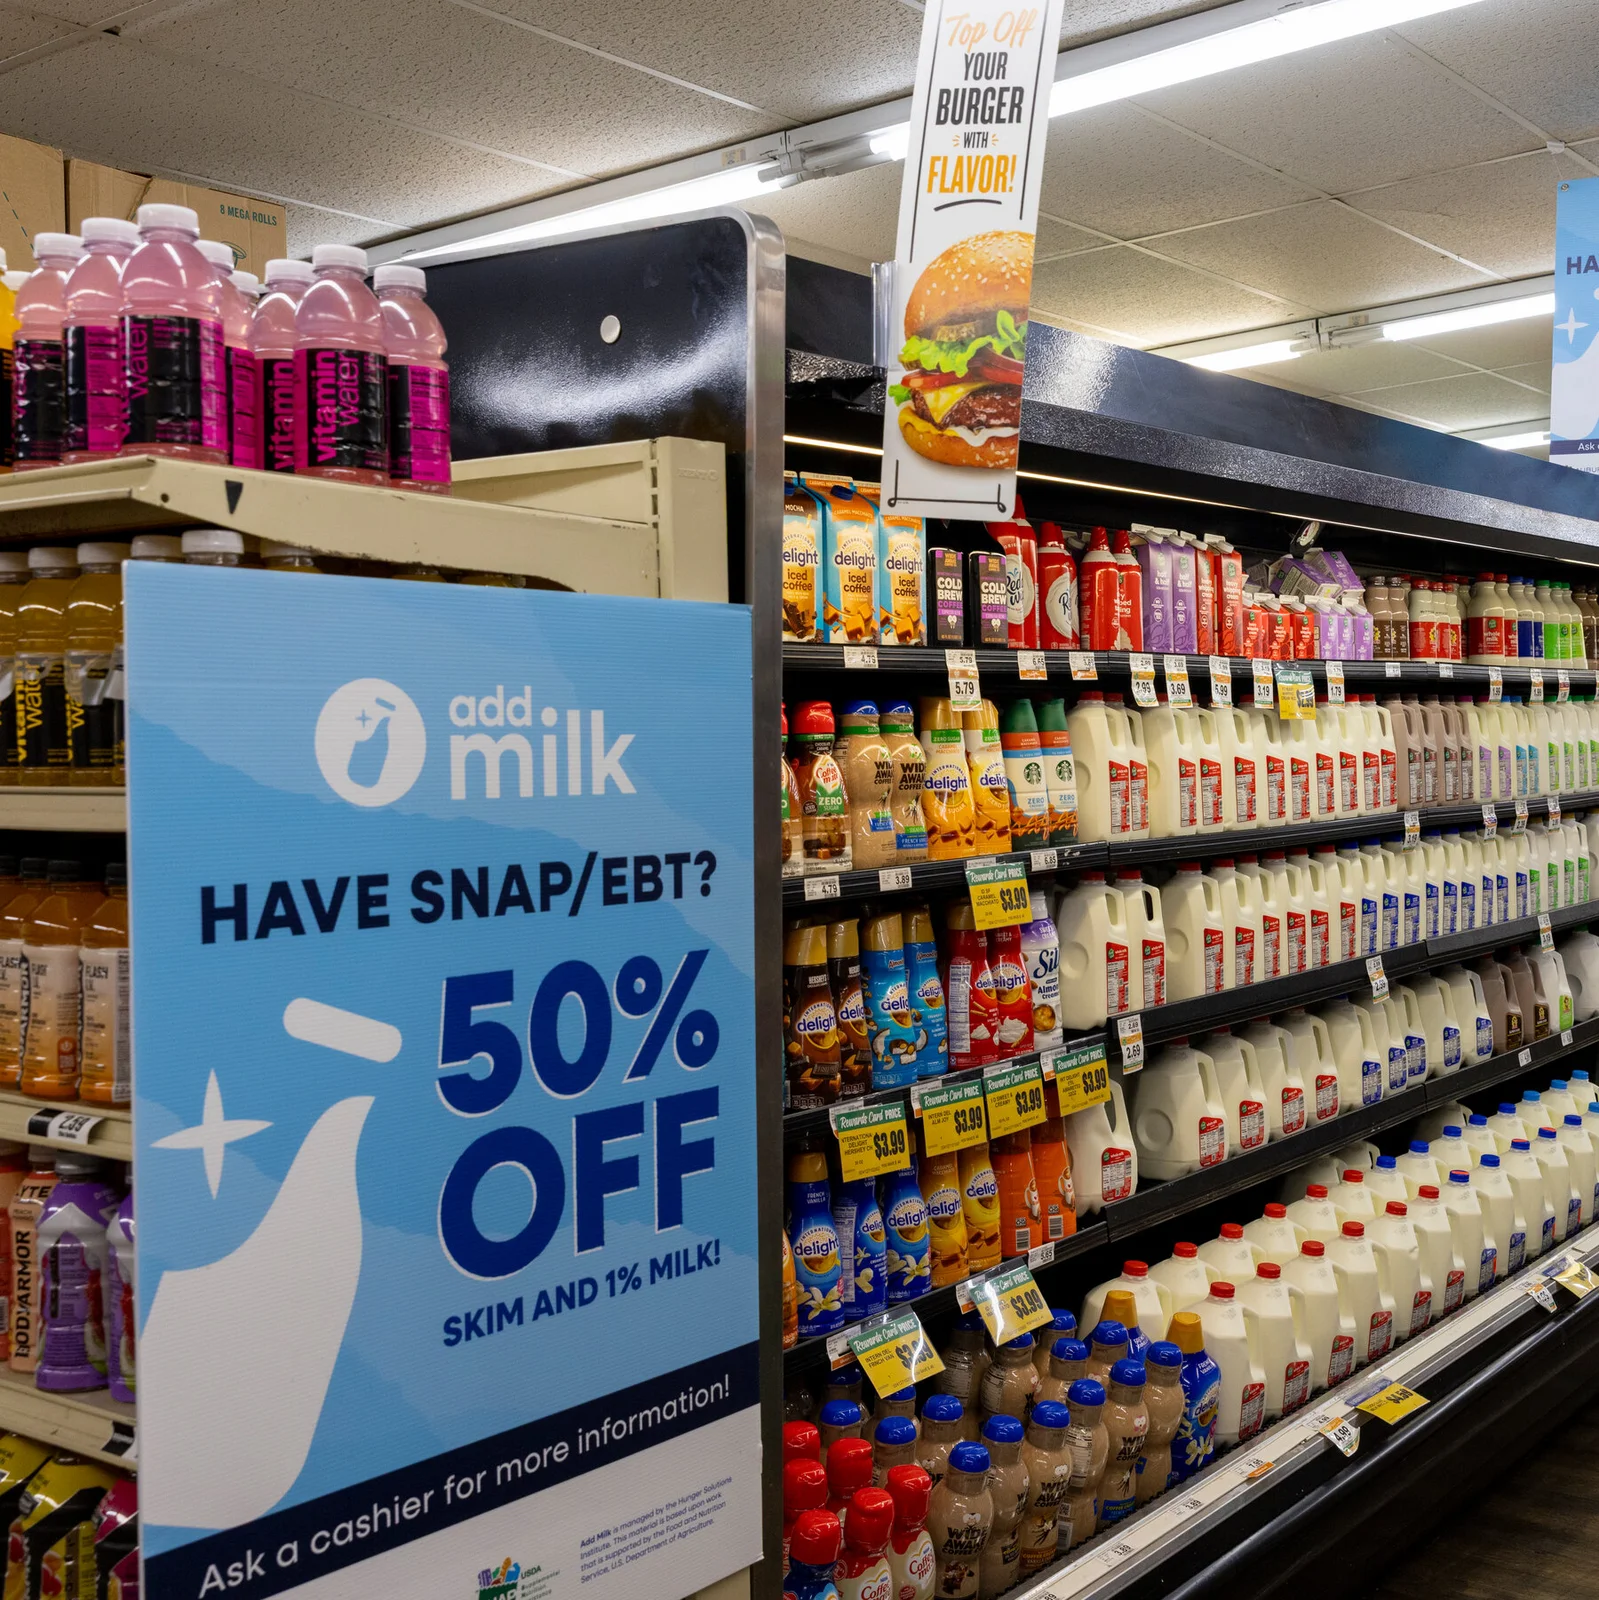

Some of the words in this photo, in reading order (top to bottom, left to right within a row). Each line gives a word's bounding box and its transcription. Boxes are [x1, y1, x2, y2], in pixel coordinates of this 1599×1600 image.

[946, 12, 988, 53] Top
[993, 7, 1038, 49] Off
[964, 51, 1008, 81] YOUR
[935, 86, 1025, 126] BURGER
[963, 131, 989, 149] WITH
[926, 153, 1018, 194] FLAVOR!
[219, 204, 226, 215] 8
[227, 206, 250, 220] MEGA
[252, 212, 277, 226] ROLLS
[129, 318, 149, 400] water
[335, 351, 361, 429] water
[311, 350, 337, 464] vitamin
[1577, 442, 1596, 451] Ask
[785, 504, 805, 513] MOCHA
[783, 548, 819, 567] elight
[834, 551, 876, 570] delight
[886, 556, 923, 574] delight
[787, 569, 808, 581] iced
[848, 572, 867, 583] iced
[898, 576, 916, 587] iced
[937, 577, 962, 589] COLD
[783, 581, 813, 591] coffee
[843, 583, 871, 594] coffee
[894, 587, 919, 597] coffee
[937, 589, 962, 601] BREW
[981, 581, 1006, 593] COLD
[937, 600, 963, 609] COFFEE
[981, 593, 1007, 605] BREW
[959, 656, 973, 664] 5.79
[25, 663, 43, 729] water
[955, 681, 975, 695] 5.79
[1136, 682, 1151, 695] 2.99
[1170, 683, 1186, 695] 3.69
[1257, 685, 1270, 696] 3.19
[1330, 686, 1341, 696] 1.79
[449, 685, 532, 727] add
[450, 706, 637, 800] milk
[925, 777, 968, 792] delight
[818, 796, 843, 806] ZERO
[1027, 797, 1045, 805] ZERO
[1058, 794, 1076, 802] ZERO
[895, 875, 910, 886] 3.89
[994, 867, 1007, 880] Card
[1007, 867, 1023, 878] PRICE
[201, 873, 390, 945] HAVE
[411, 850, 717, 924] SNAP/EBT?
[821, 886, 838, 896] 4.79
[999, 886, 1028, 913] $3.99
[85, 964, 109, 979] FLASH
[436, 948, 720, 1119] 50%
[1056, 1057, 1078, 1071] Rewards
[1078, 1054, 1091, 1065] Card
[1090, 1048, 1103, 1060] PRICE
[1126, 1044, 1141, 1059] 2.69
[987, 1076, 1011, 1091] Rewards
[1010, 1072, 1024, 1086] Card
[1024, 1067, 1039, 1080] PRICE
[1081, 1067, 1107, 1096] $3.99
[923, 1091, 949, 1107] Rewards
[949, 1087, 963, 1102] Card
[963, 1085, 980, 1098] PRICE
[994, 1100, 1011, 1108] CREAMY
[1015, 1086, 1043, 1117] $3.99
[58, 1113, 91, 1133] 2.59
[840, 1113, 868, 1130] Rewards
[868, 1110, 883, 1123] Card
[884, 1108, 902, 1119] PRICE
[954, 1106, 983, 1136] $3.99
[848, 1140, 868, 1148] DELIGHT
[873, 1129, 906, 1161] $3.99
[437, 1085, 720, 1281] OFF
[15, 1186, 52, 1199] YTE
[806, 1196, 826, 1204] VANILLA
[807, 1191, 825, 1199] FRENCH
[794, 1238, 839, 1257] delight
[1000, 1276, 1013, 1291] Card
[1013, 1271, 1030, 1284] PRICE
[14, 1229, 32, 1359] BODYARMOR
[443, 1297, 524, 1347] SKIM
[532, 1276, 598, 1322] AND
[605, 1263, 643, 1298] 1%
[649, 1238, 721, 1286] MILK!
[1010, 1288, 1044, 1320] $3.99
[853, 1331, 883, 1352] Rewards
[882, 1323, 898, 1339] Card
[898, 1317, 917, 1334] PRICE
[865, 1352, 882, 1363] INTERN
[882, 1349, 892, 1357] DEL
[869, 1358, 885, 1368] FRNCH
[885, 1354, 895, 1362] VAN
[1333, 1425, 1352, 1442] 4.99
[198, 1549, 266, 1600] Ask
[276, 1539, 298, 1568] a
[310, 1489, 435, 1555] cashier
[443, 1471, 488, 1505] for
[496, 1440, 570, 1486] more
[577, 1374, 730, 1455] information!
[580, 1535, 596, 1549] Add
[596, 1528, 612, 1541] Milk
[612, 1526, 619, 1535] is
[619, 1510, 655, 1532] managed
[655, 1506, 665, 1518] by
[665, 1500, 678, 1511] the
[678, 1488, 703, 1506] Hunger
[703, 1475, 733, 1495] Solutions
[580, 1542, 612, 1560] Institute.
[614, 1533, 628, 1546] This
[628, 1519, 659, 1540] material
[665, 1507, 688, 1523] based
[688, 1500, 706, 1513] upon
[705, 1492, 722, 1505] work
[947, 1525, 988, 1540] WIDE
[580, 1559, 597, 1572] that
[605, 1538, 642, 1563] supported
[642, 1535, 652, 1548] by
[653, 1528, 665, 1540] the
[666, 1520, 683, 1534] Food
[683, 1514, 698, 1527] and
[698, 1501, 727, 1519] Nutrition
[580, 1565, 610, 1584] Service,
[611, 1557, 625, 1570] U.S.
[625, 1538, 668, 1564] Department
[668, 1533, 677, 1544] of
[677, 1518, 715, 1540] Agriculture.
[520, 1565, 542, 1580] USDA
